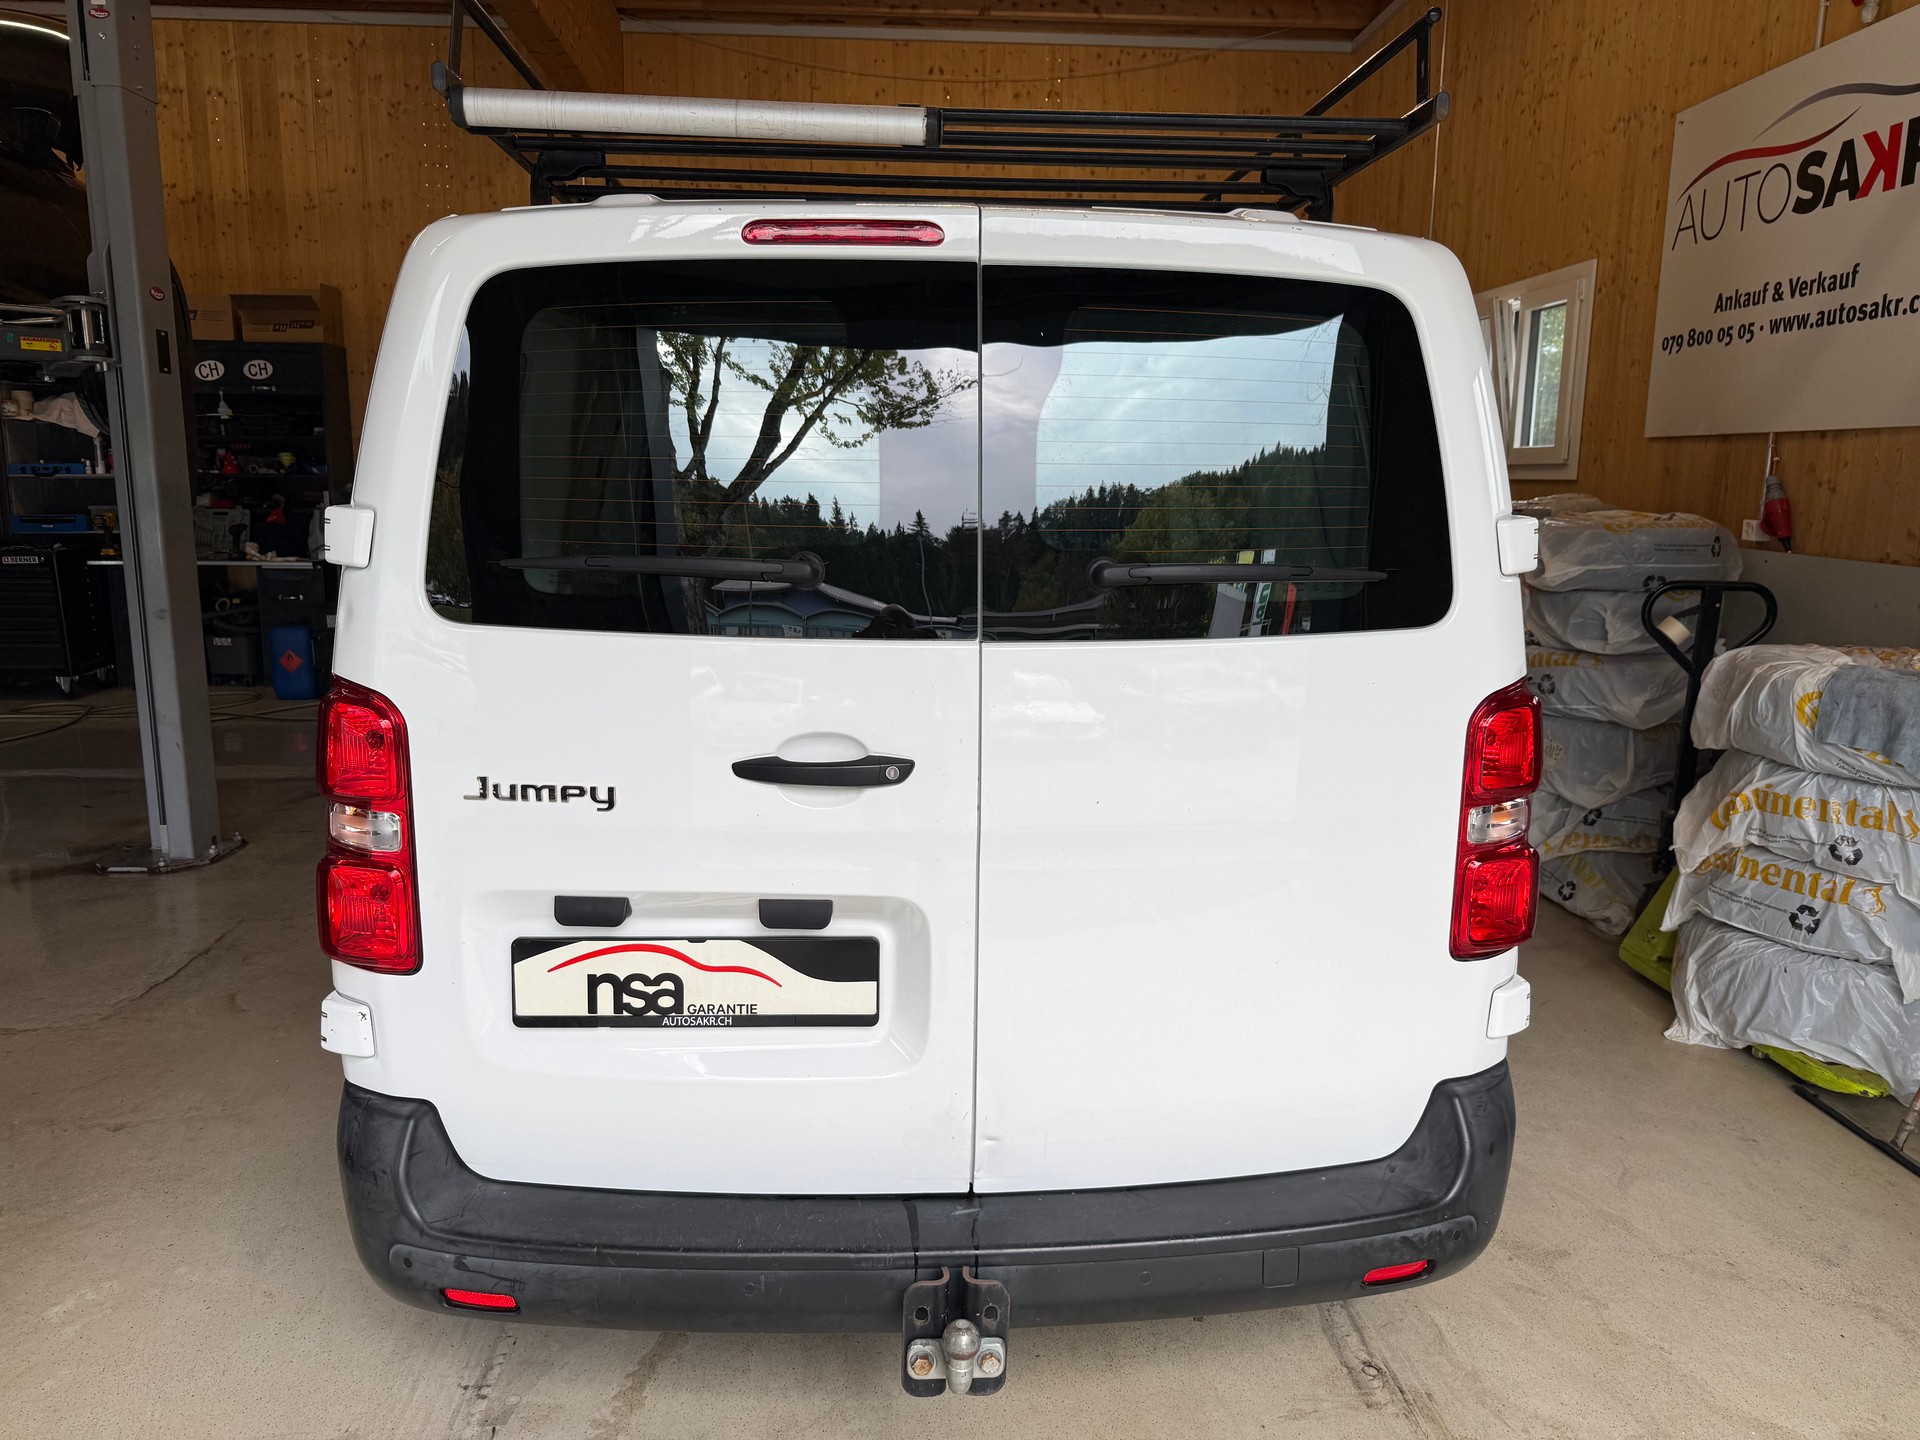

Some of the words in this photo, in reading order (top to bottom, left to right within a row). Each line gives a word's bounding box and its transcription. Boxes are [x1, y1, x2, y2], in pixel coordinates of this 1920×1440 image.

[1713, 281, 1770, 314] Ankauf
[1771, 281, 1784, 303] &
[1788, 262, 1861, 299] Verkauf
[1661, 334, 1684, 356] 079
[1686, 328, 1714, 348] 800
[1717, 325, 1734, 347] 05
[1737, 321, 1755, 344] 05
[198, 362, 220, 379] CH
[248, 362, 269, 377] CH
[463, 776, 616, 812] Jumpy
[1694, 848, 1857, 906] Connental
[587, 973, 684, 1015] nsa
[687, 1003, 758, 1015] GARANTIE
[662, 1016, 733, 1026] AUTOSAKR.CH
